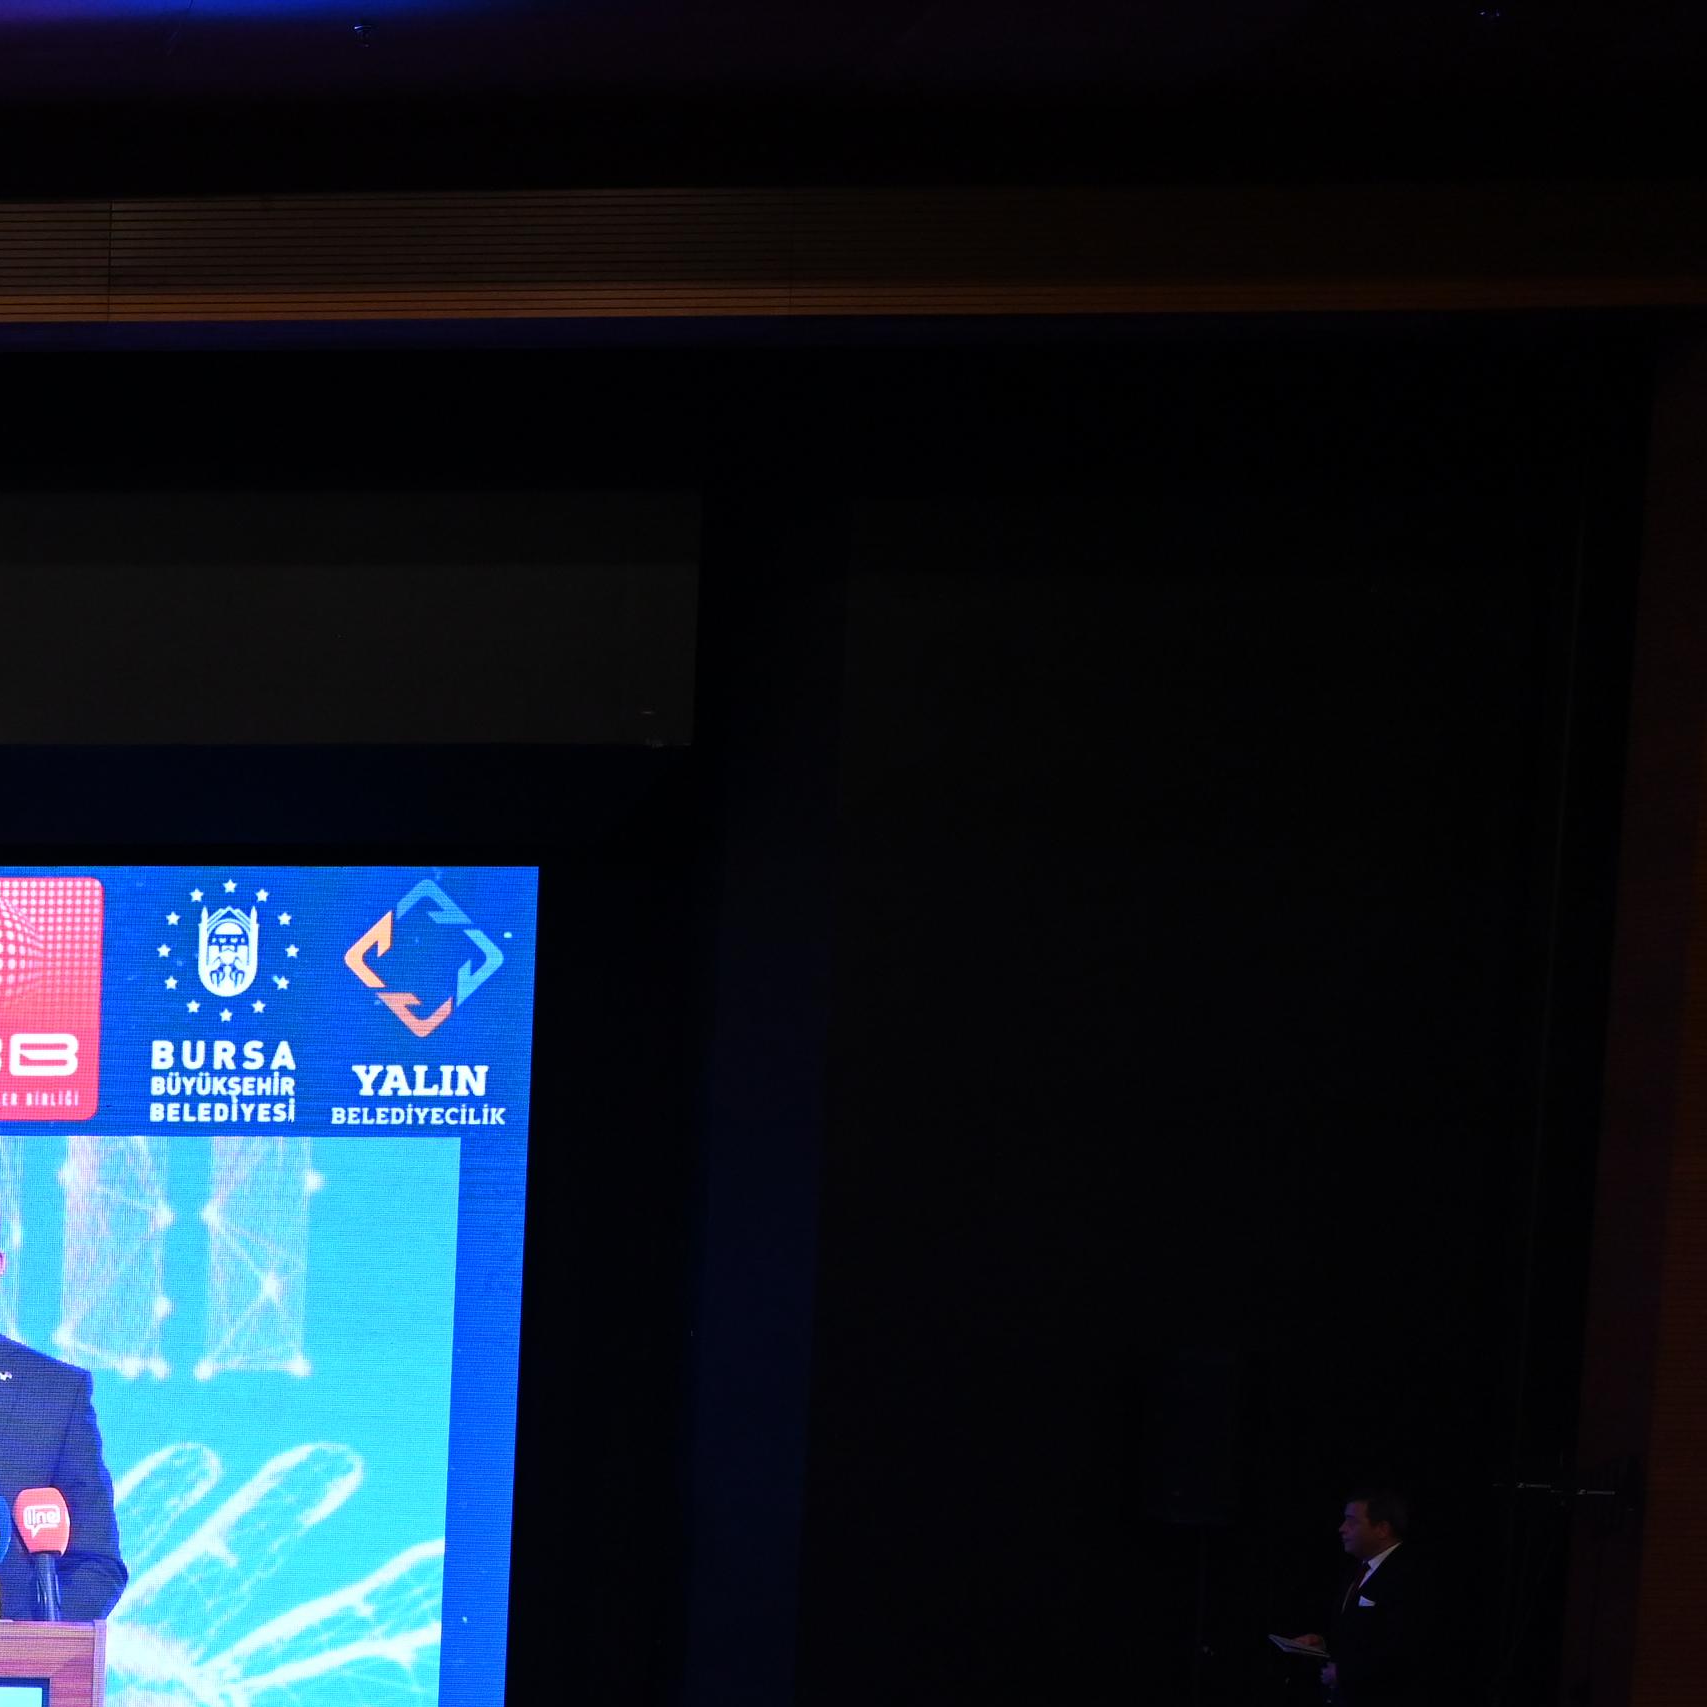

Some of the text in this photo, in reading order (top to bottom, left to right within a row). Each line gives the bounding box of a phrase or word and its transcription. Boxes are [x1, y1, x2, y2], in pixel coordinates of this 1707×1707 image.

[151, 1040, 296, 1070] BURSA
[151, 1072, 295, 1100] BÜYÜKŞEHİR
[351, 1064, 489, 1097] YALIN
[150, 1098, 295, 1123] BELEDİYESİ
[331, 1103, 507, 1126] BELEDİYECİLİK
